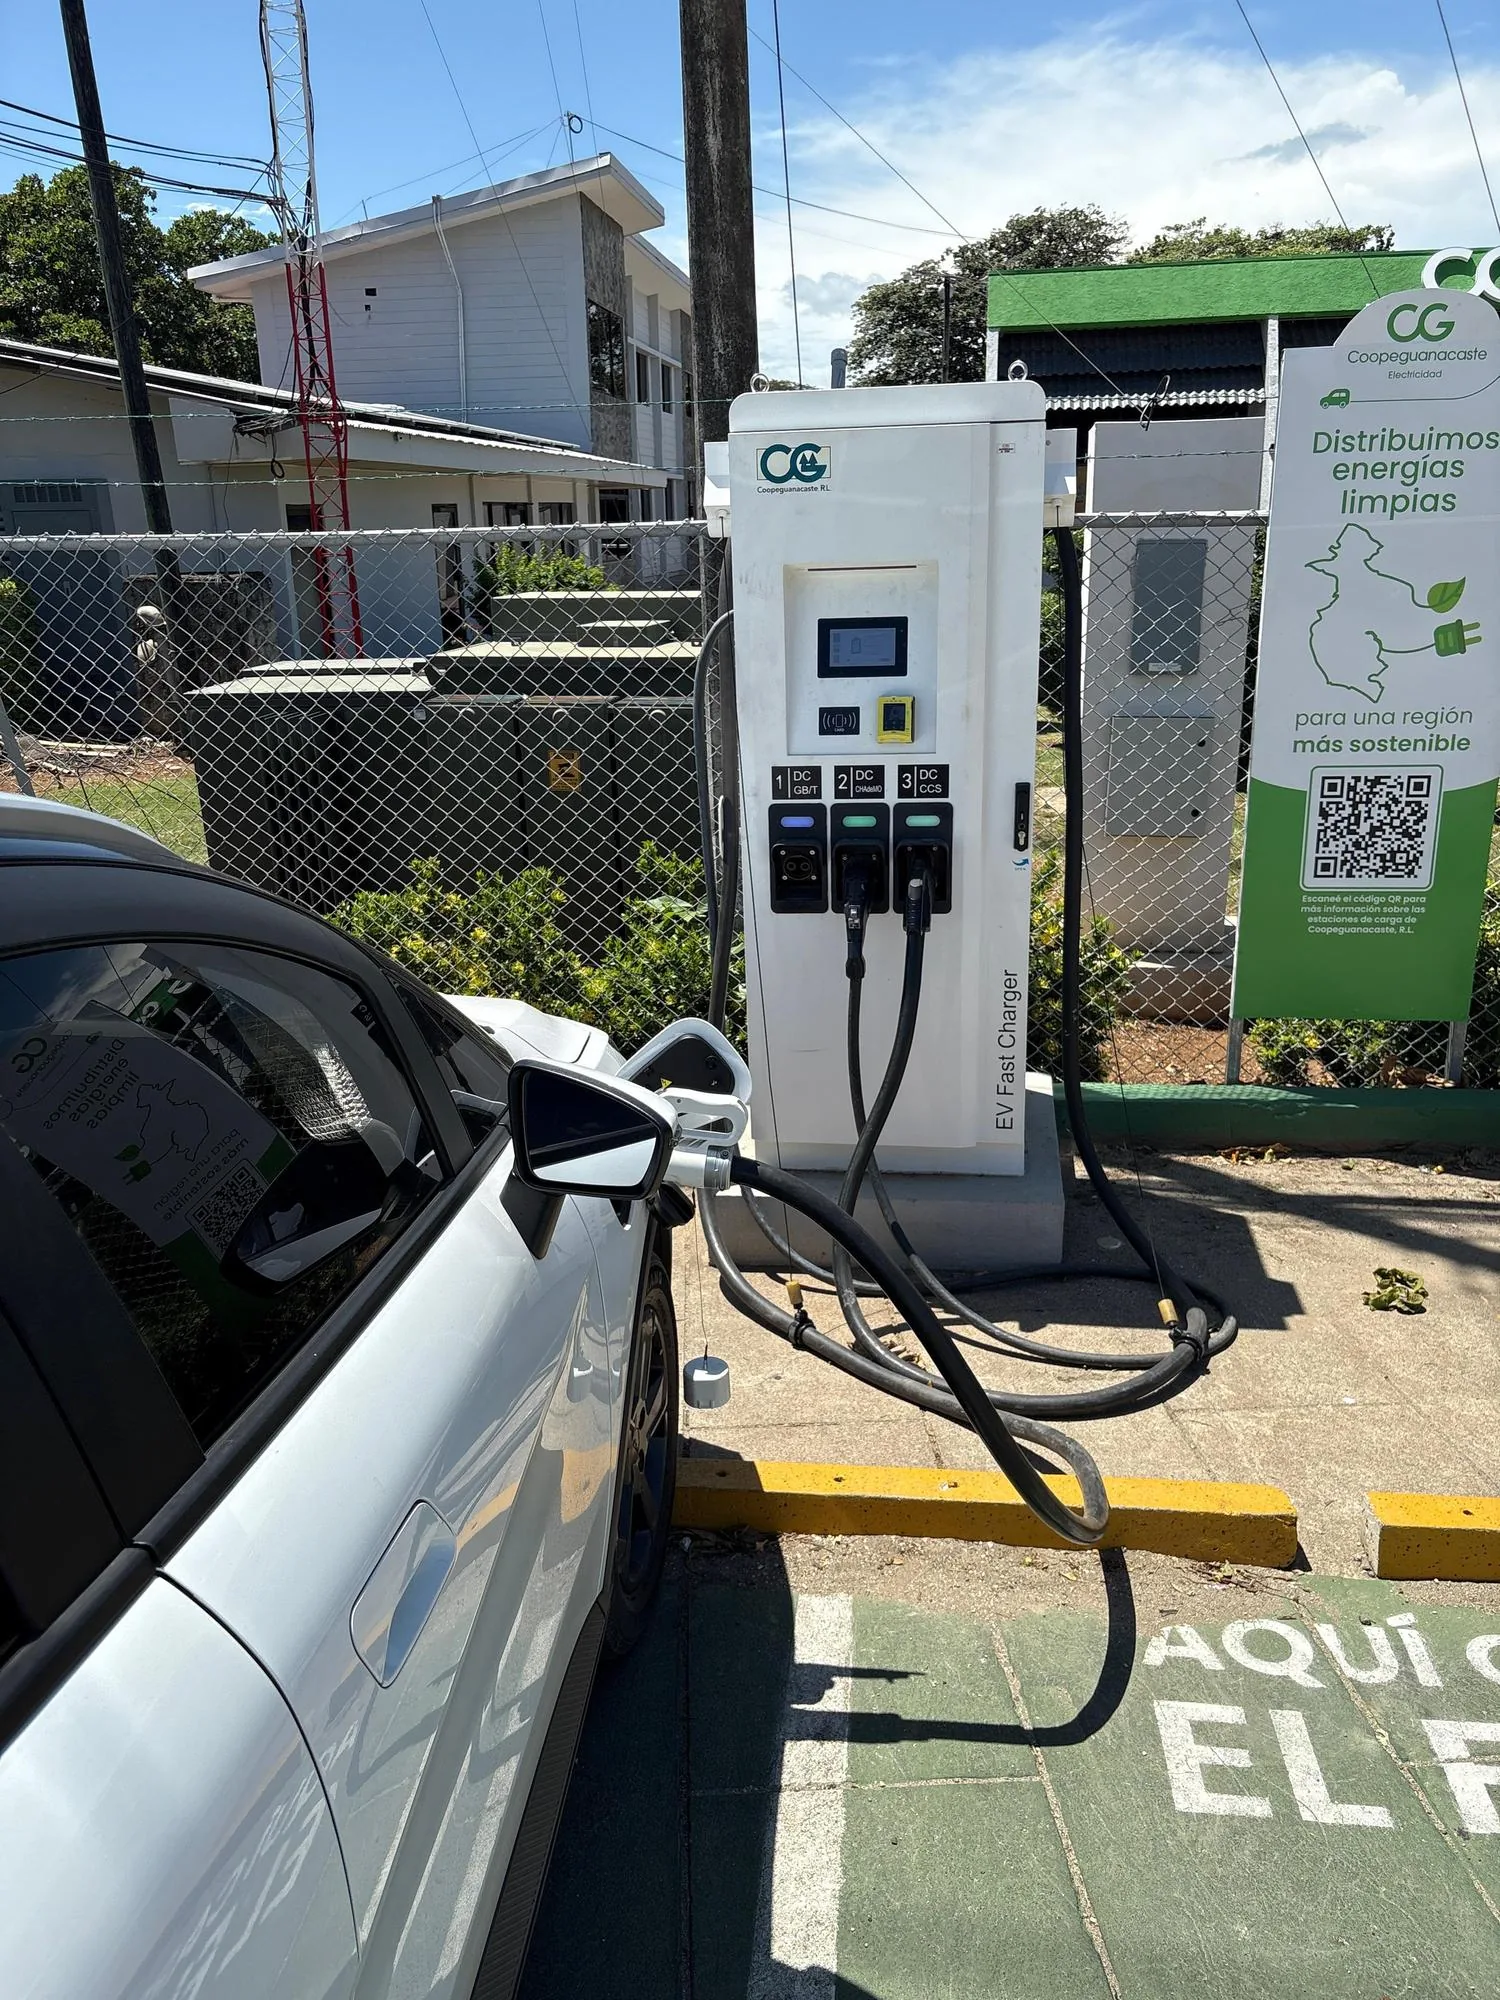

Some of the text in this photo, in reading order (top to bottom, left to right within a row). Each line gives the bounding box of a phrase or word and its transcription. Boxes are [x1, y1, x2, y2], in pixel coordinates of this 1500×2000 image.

[1386, 302, 1456, 343] CG
[1347, 347, 1488, 365] Coopeguanacaste
[1388, 369, 1443, 380] Electricidad
[1312, 426, 1500, 454] Distribuimos
[760, 442, 828, 484] CG
[1332, 453, 1465, 487] energías
[756, 484, 819, 495] Coopeguanacaste
[1340, 487, 1457, 521] limpias
[1295, 706, 1473, 732] para una región
[1292, 733, 1471, 753] más sostenible
[775, 774, 783, 790] 1
[793, 770, 811, 781] DC
[838, 773, 848, 790] 2
[855, 769, 874, 781] DC
[901, 772, 912, 789] 3
[919, 769, 938, 780] DC
[793, 785, 819, 795] GB/T
[919, 784, 942, 794] CCS
[1342, 894, 1352, 903] el
[1353, 893, 1386, 905] código
[1387, 894, 1402, 904] QR
[1403, 896, 1427, 905] para
[1300, 904, 1426, 913] más información sobre las
[1307, 915, 1417, 926] estaciones de carga de
[1307, 924, 1415, 936] Coopeguanacaste, R.L.
[995, 969, 1022, 1130] EV Fast Charger
[1142, 1612, 1444, 1689] AQUÍ
[1153, 1699, 1395, 1829] EL
